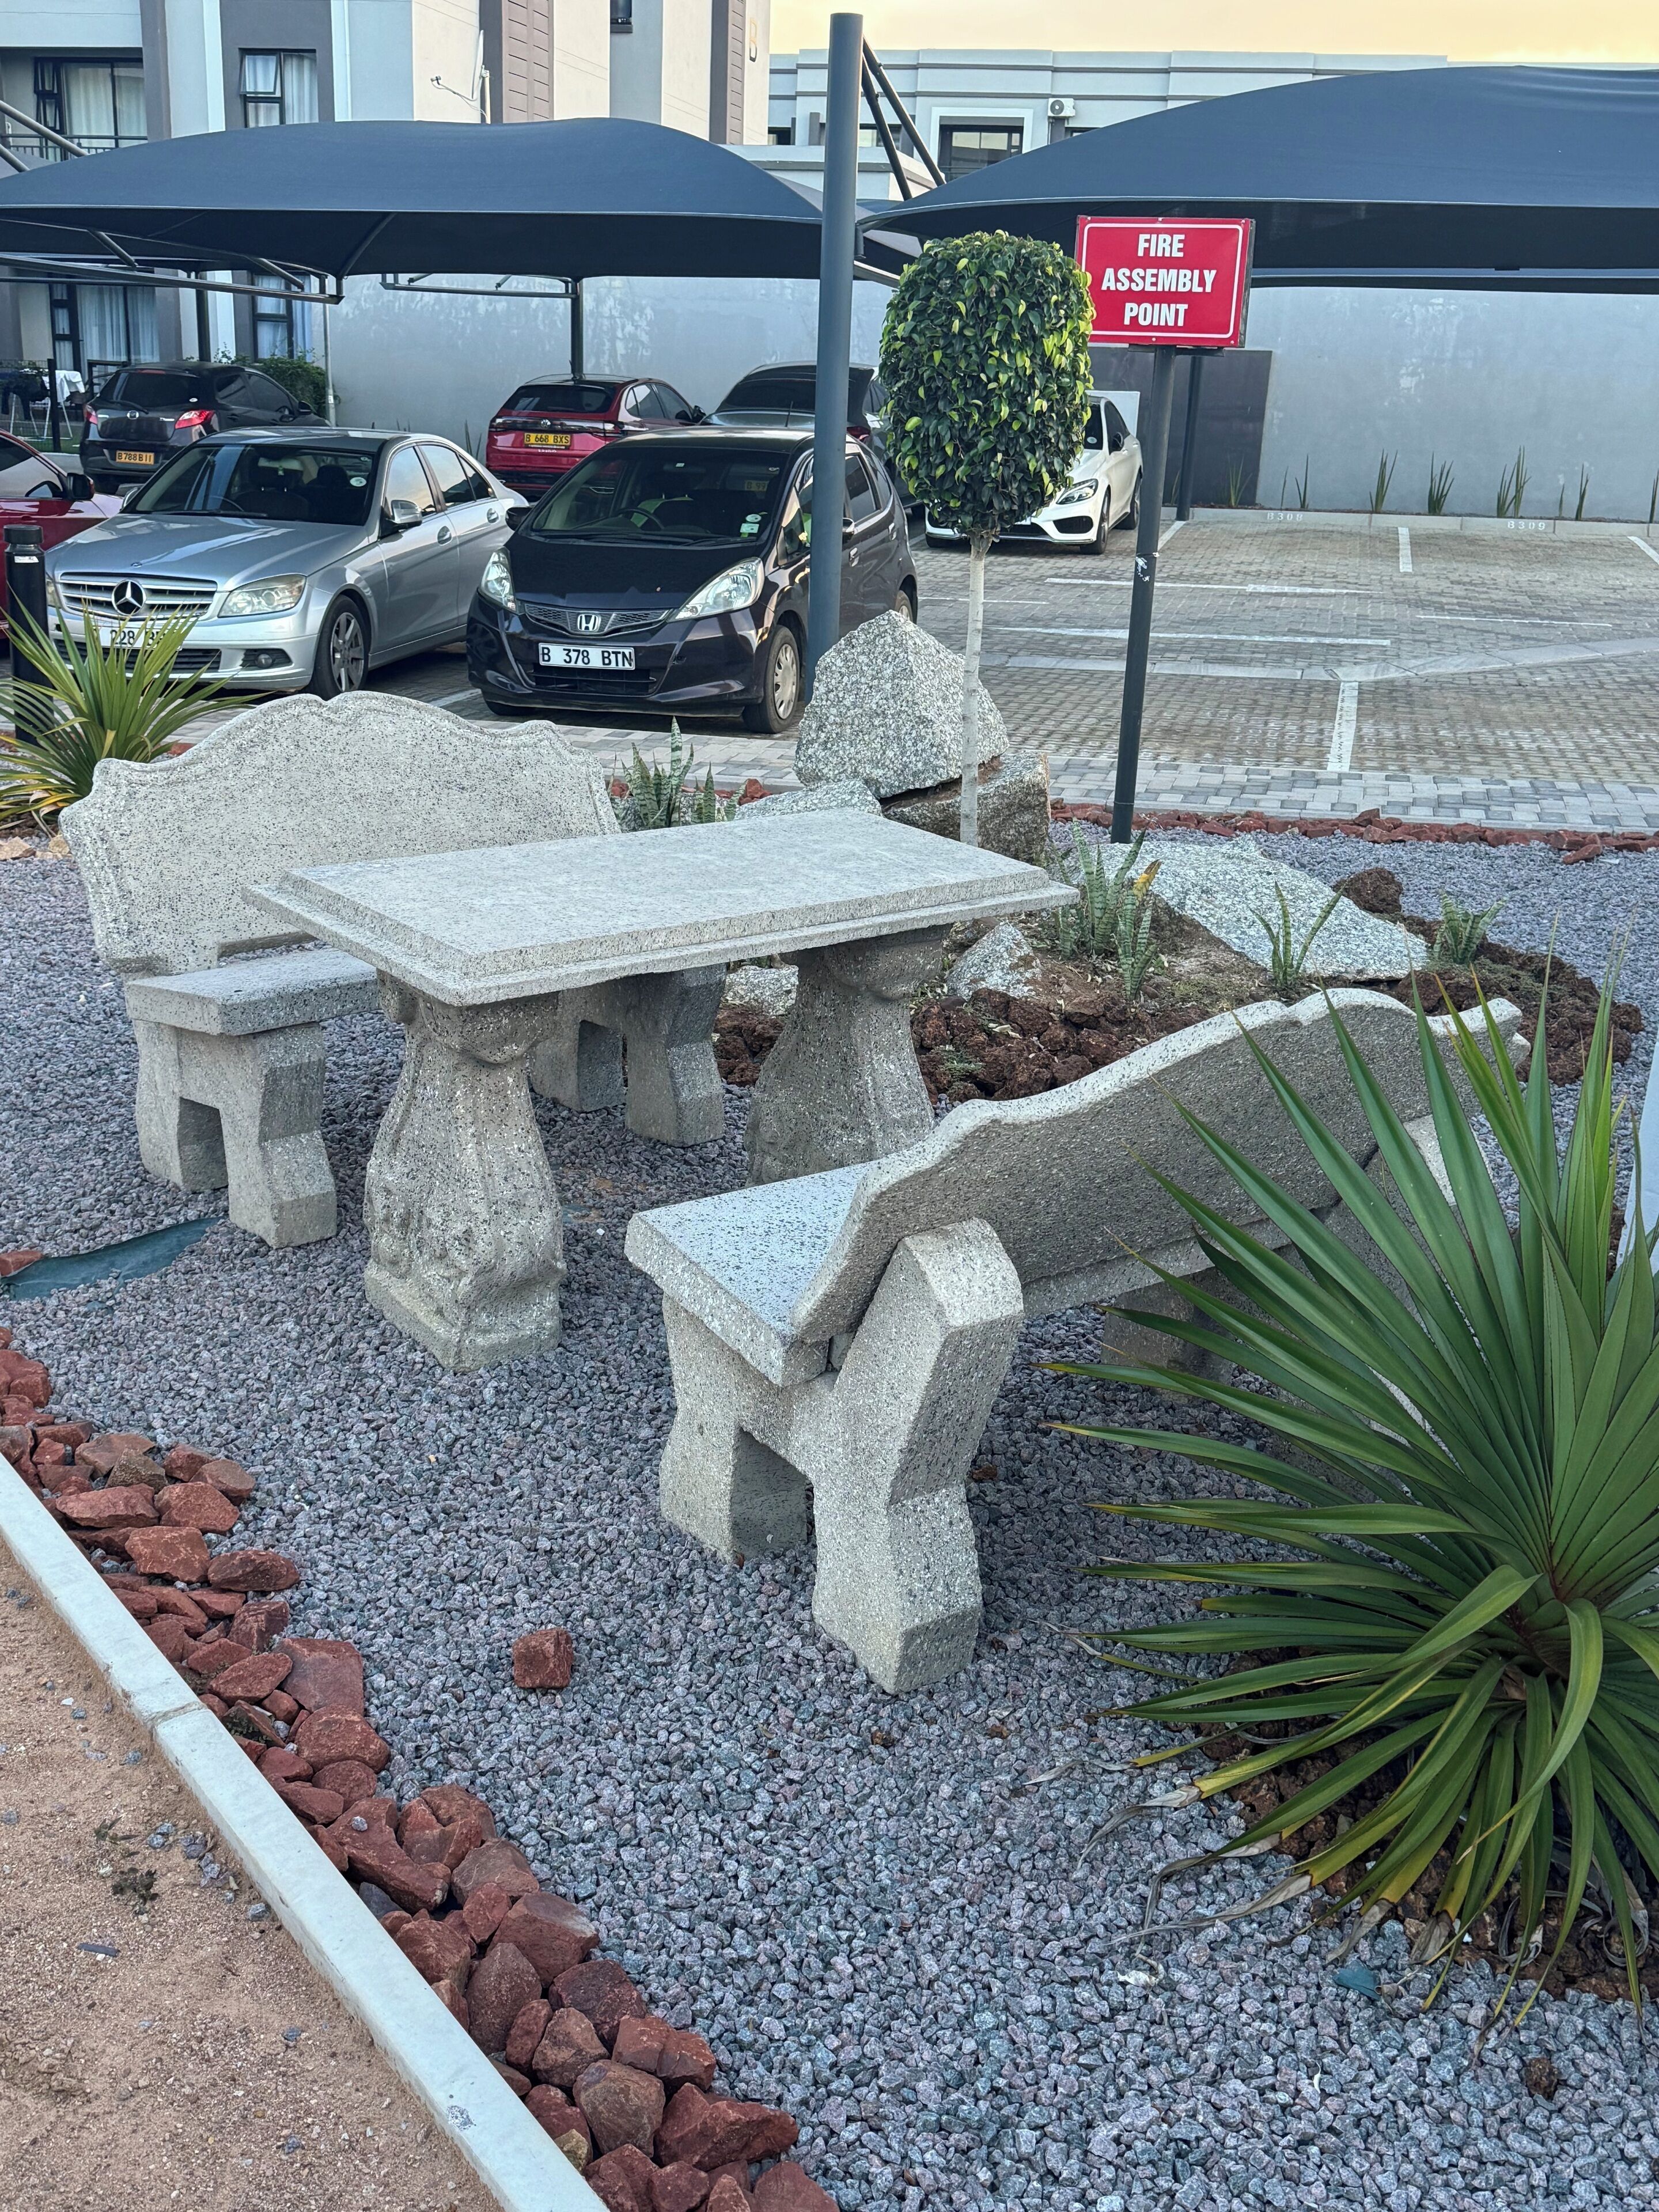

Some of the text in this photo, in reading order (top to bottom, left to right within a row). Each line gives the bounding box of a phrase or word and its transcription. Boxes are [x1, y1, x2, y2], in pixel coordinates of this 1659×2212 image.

[1138, 234, 1185, 257] FIRE
[1101, 268, 1217, 292] ASSEMBLY
[1124, 302, 1188, 326] POINT
[525, 434, 569, 444] B 668 BXS
[1508, 521, 1546, 530] B309
[541, 647, 632, 666] B 378 BTN
